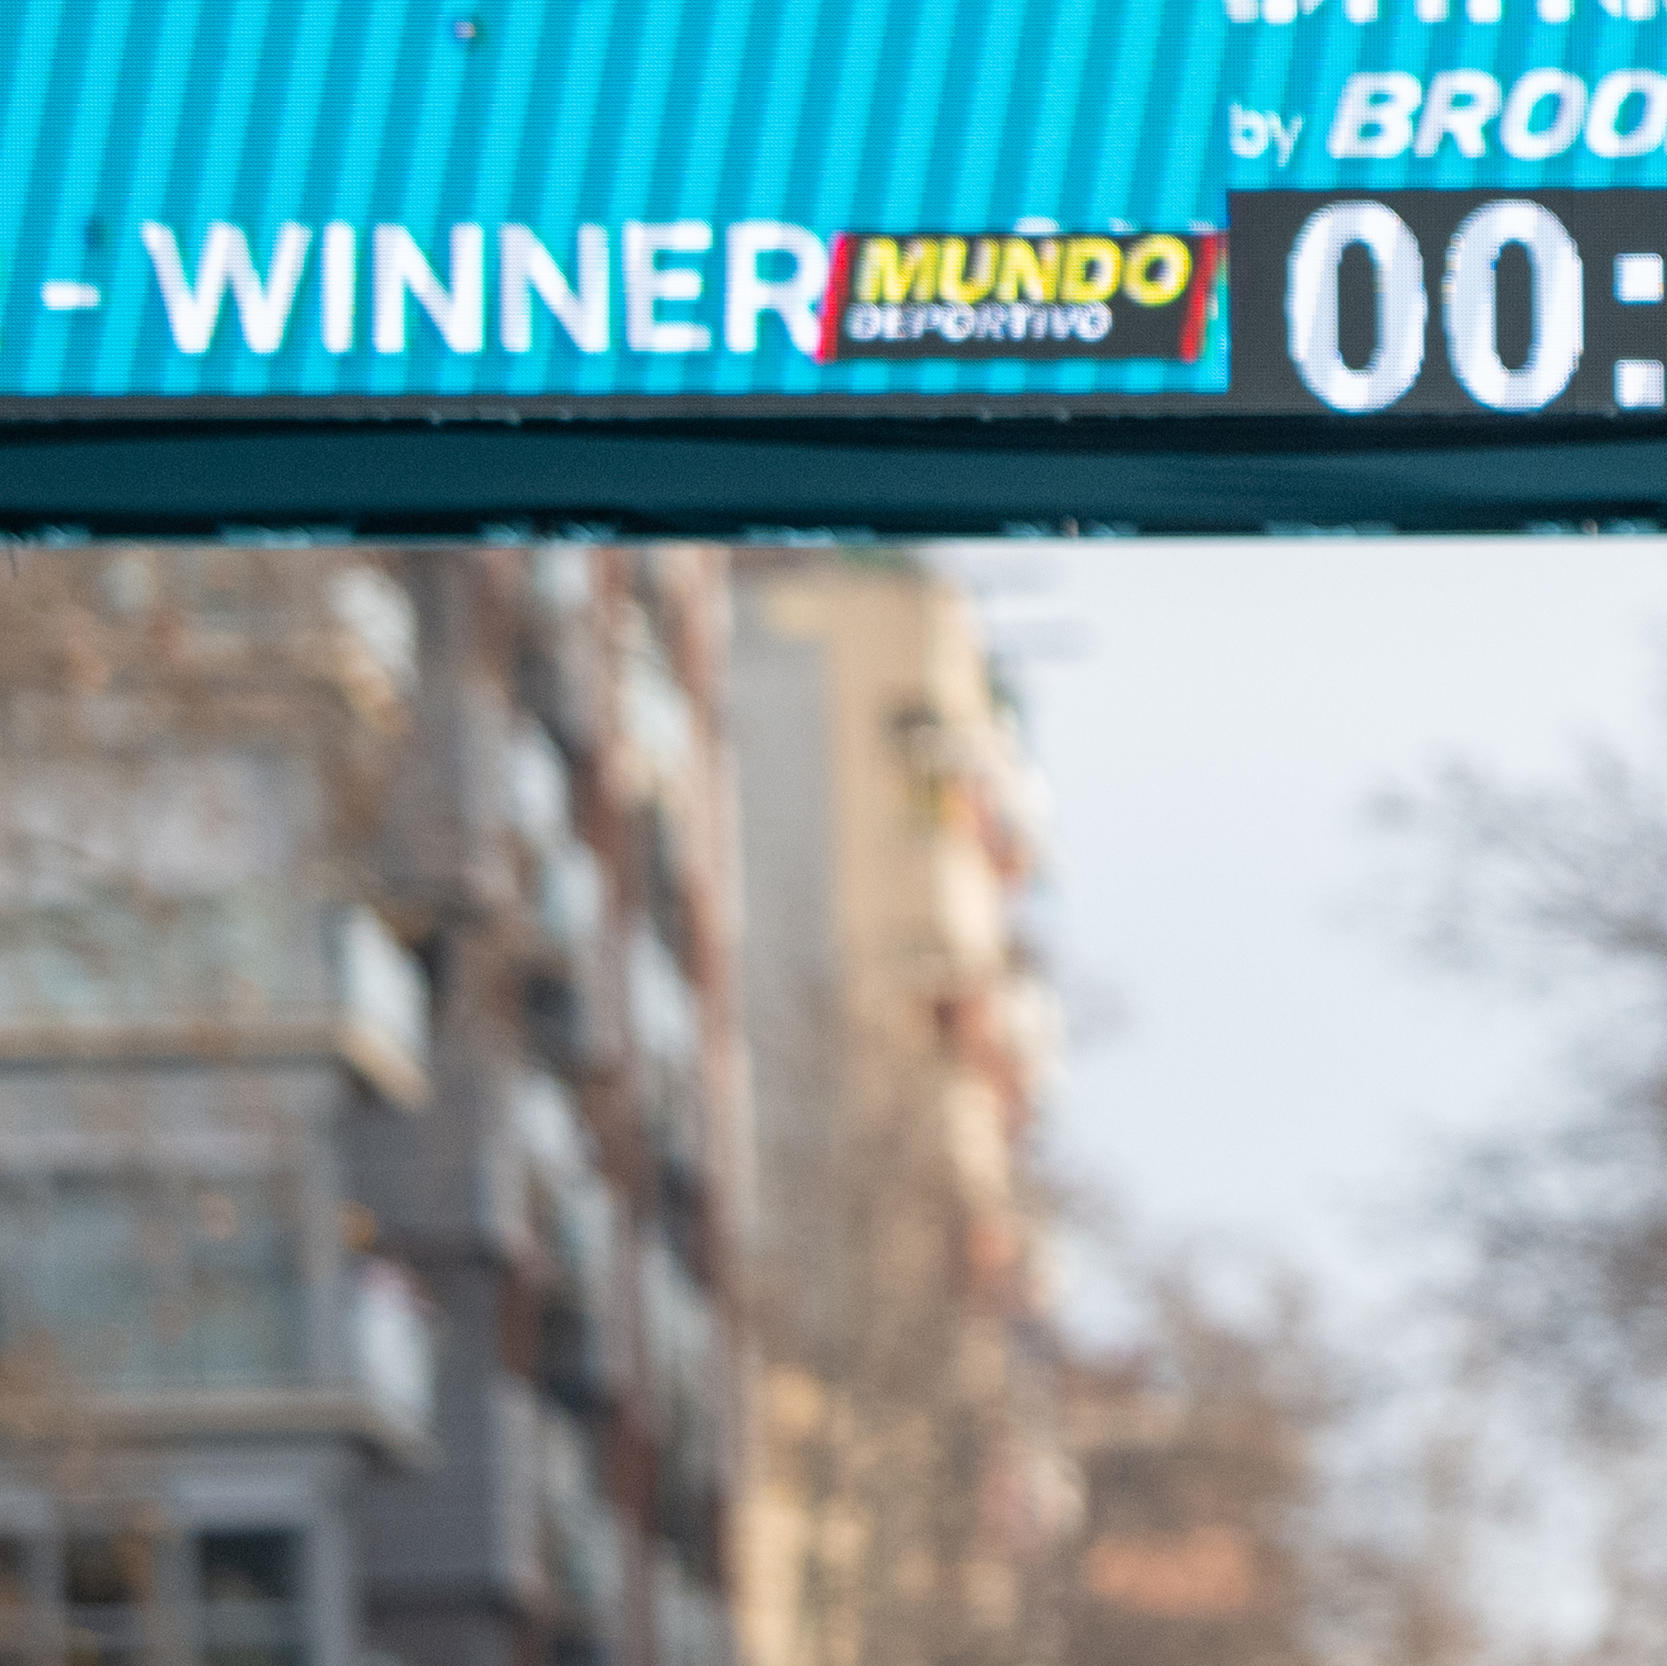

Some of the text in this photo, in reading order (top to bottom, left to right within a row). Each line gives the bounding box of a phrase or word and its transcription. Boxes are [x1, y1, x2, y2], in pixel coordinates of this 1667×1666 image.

[1230, 104, 1303, 166] by
[142, 219, 829, 355] WINNER
[856, 233, 1193, 308] MUNDO
[846, 302, 1113, 342] DEPORTIVO
